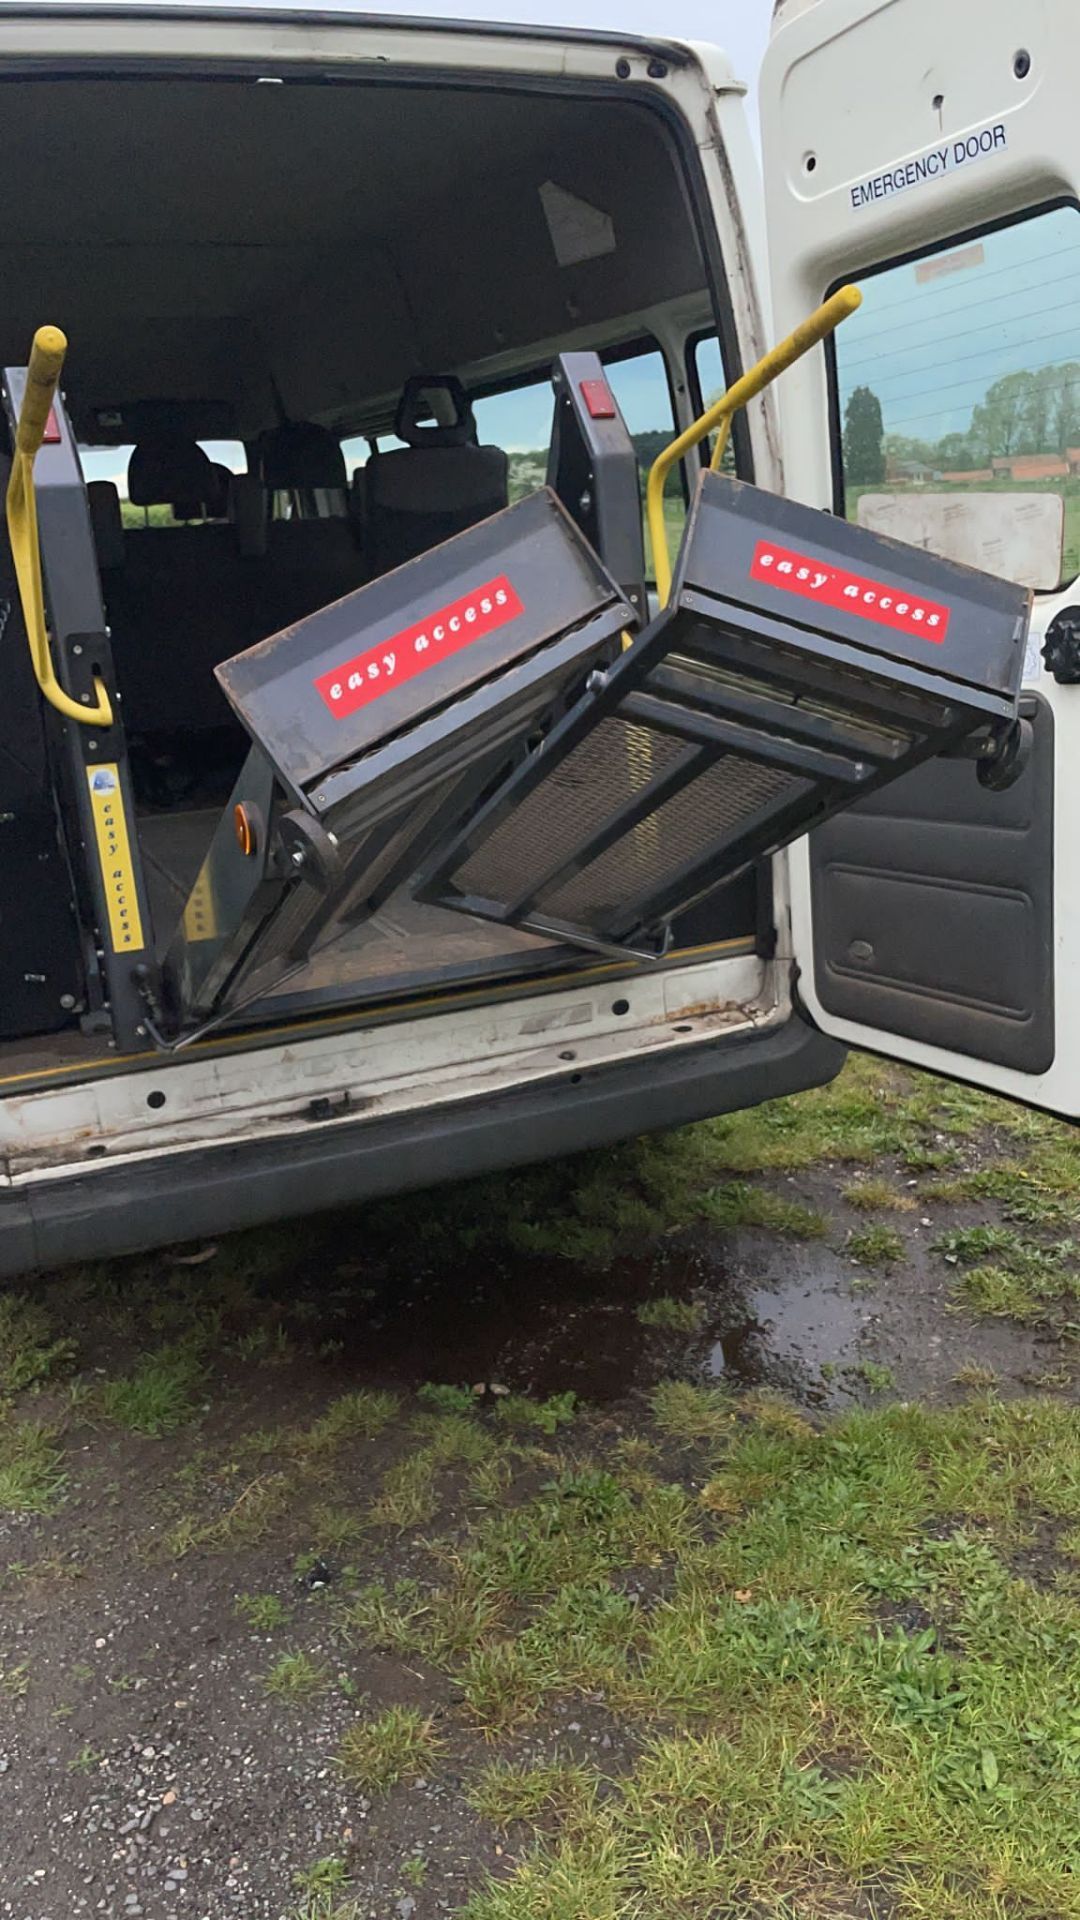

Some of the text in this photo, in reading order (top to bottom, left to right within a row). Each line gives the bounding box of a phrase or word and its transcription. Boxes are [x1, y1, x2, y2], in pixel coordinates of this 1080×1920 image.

[850, 124, 1006, 208] EMERGENCY DOOR
[759, 554, 941, 626] easy access
[329, 589, 508, 700] easy access
[103, 804, 132, 943] easy access
